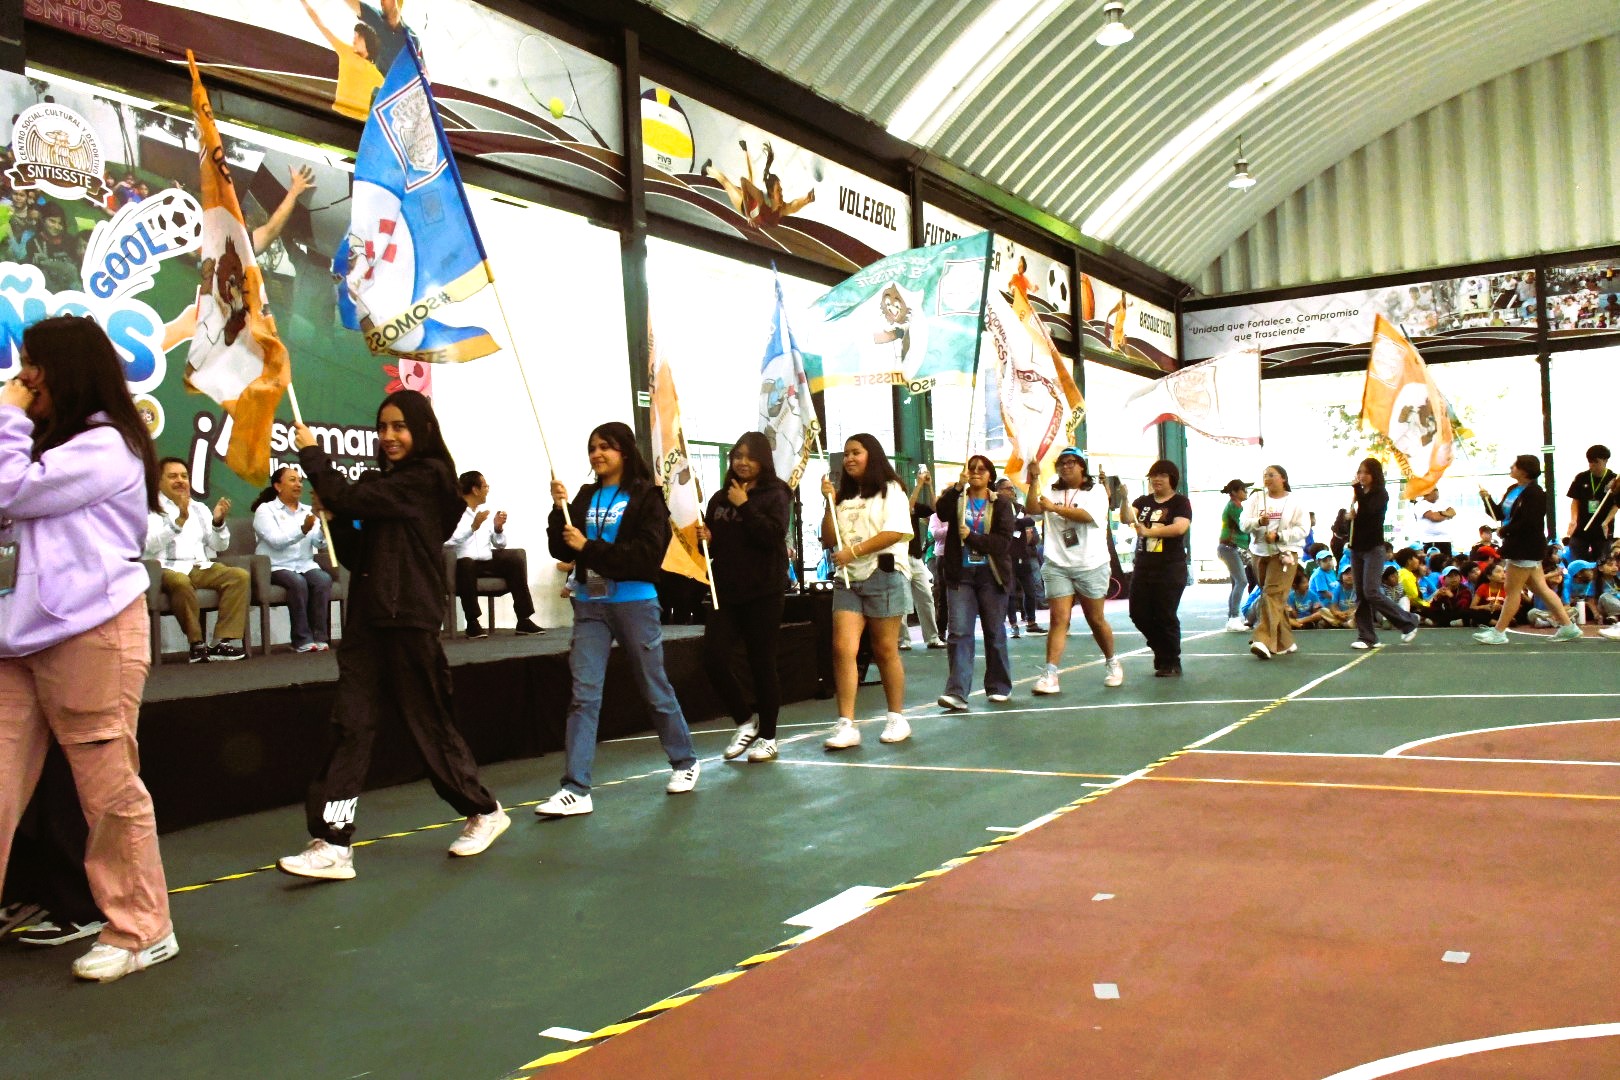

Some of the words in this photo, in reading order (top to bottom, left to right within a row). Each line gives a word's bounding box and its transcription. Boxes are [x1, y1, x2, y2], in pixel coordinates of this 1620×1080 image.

[26, 0, 160, 53] SNTISSSTE
[17, 130, 28, 161] CENTRO
[44, 108, 81, 128] CULTURAL
[86, 133, 100, 175] DEPORTIVO
[27, 165, 92, 189] SNTISSSTE
[839, 185, 897, 232] VOLEIBOL
[89, 221, 169, 299] GOOL
[1139, 310, 1172, 339] BASQUETBOL
[1227, 322, 1245, 332] que
[1296, 308, 1360, 322] Compromiso
[1234, 333, 1252, 343] que
